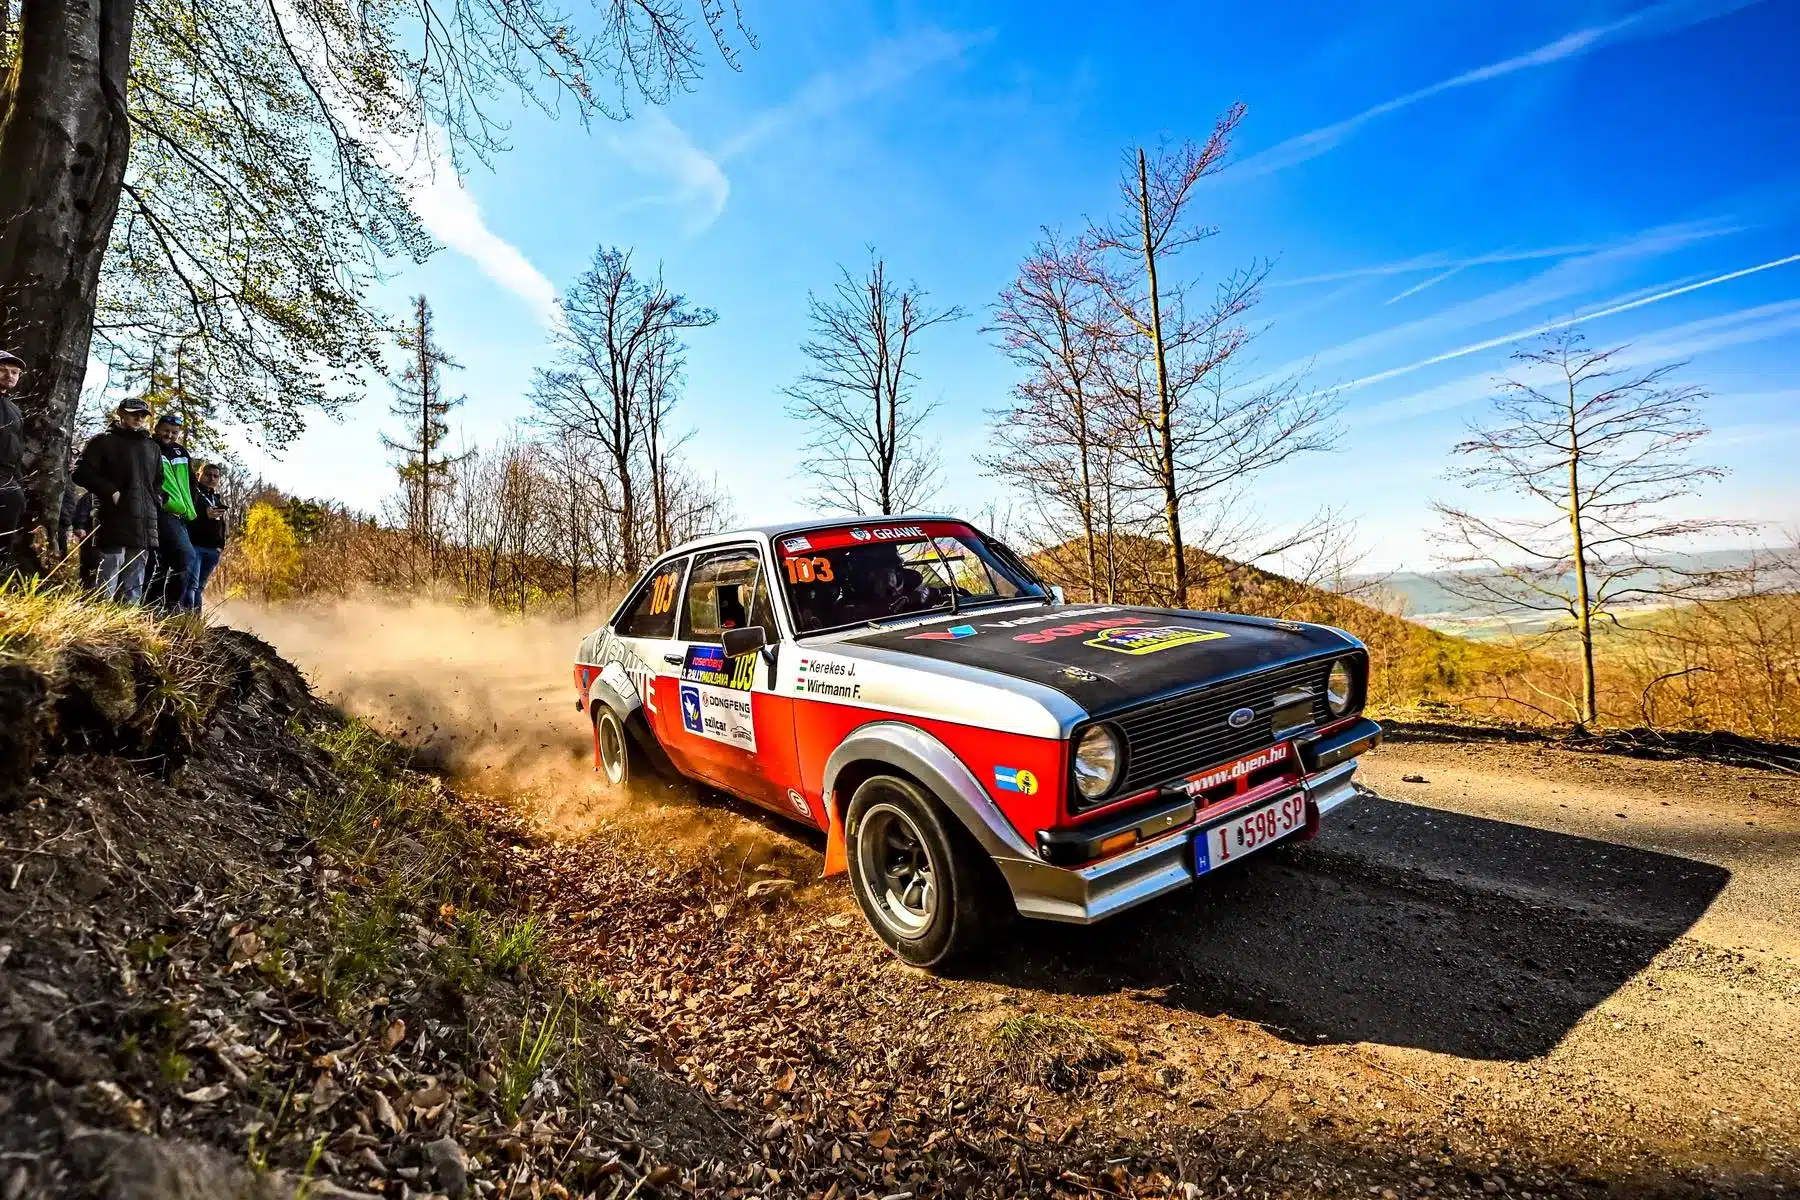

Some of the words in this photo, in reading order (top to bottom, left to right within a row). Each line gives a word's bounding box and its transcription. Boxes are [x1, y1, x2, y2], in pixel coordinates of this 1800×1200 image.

[873, 526, 925, 540] GRAWE
[784, 557, 834, 584] 103
[650, 572, 678, 615] 103
[692, 657, 724, 671] rosenberg
[730, 651, 758, 690] 103
[809, 659, 846, 676] Kerekes
[847, 663, 856, 677] J.
[807, 679, 851, 698] Wirtmann
[852, 685, 861, 699] F.
[709, 695, 751, 714] DONGFENG
[704, 716, 727, 732] szilcar
[1186, 746, 1287, 794] www.duen.hu
[1244, 796, 1304, 848] 598-SP
